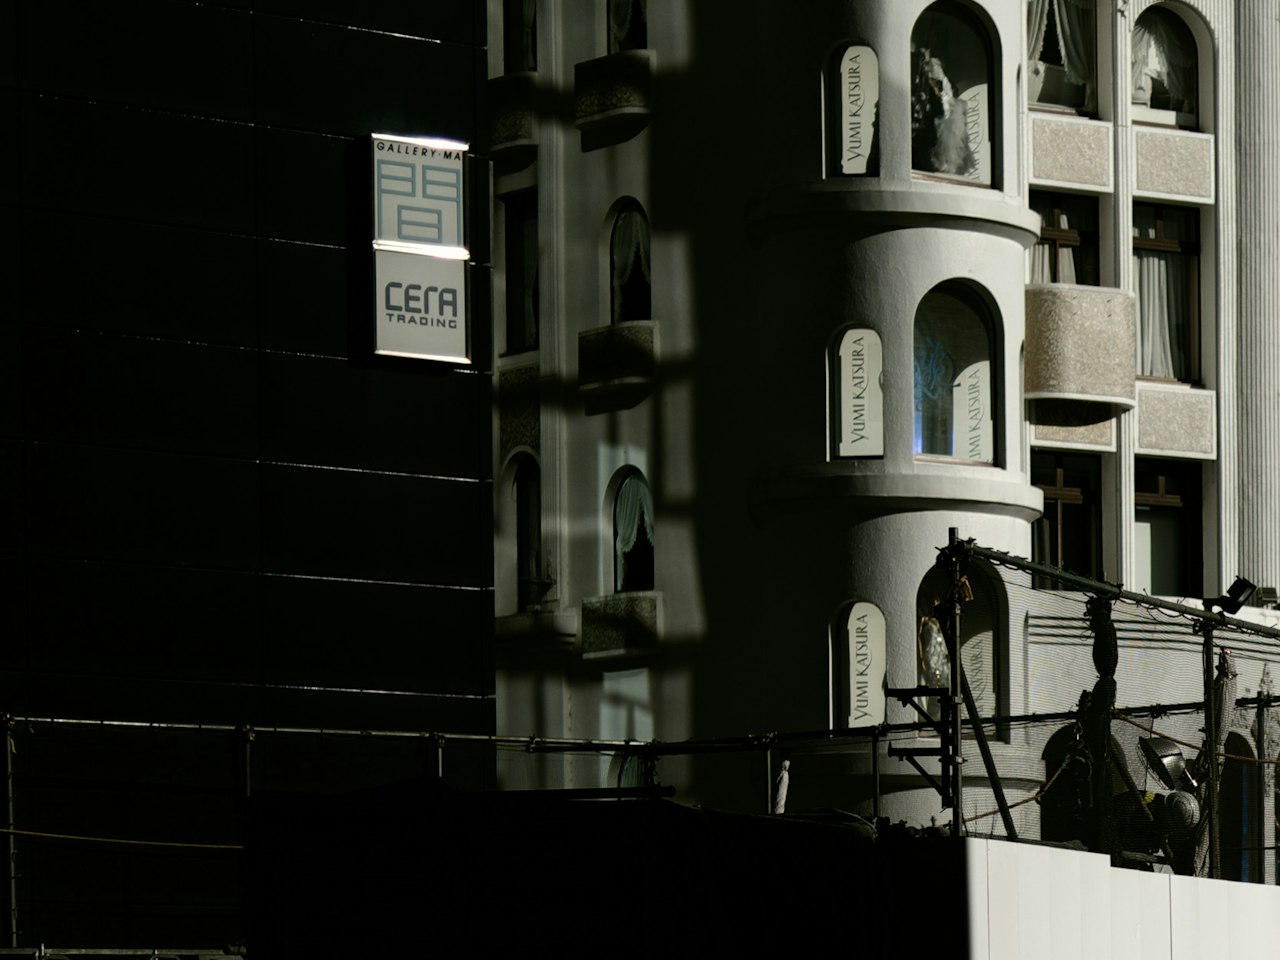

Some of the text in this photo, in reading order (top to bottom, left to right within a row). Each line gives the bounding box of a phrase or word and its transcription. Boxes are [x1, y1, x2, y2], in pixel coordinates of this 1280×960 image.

[847, 54, 866, 162] YUMI KATSURA
[385, 313, 458, 329] TRADING
[851, 336, 869, 444] YUMI KATSURA
[968, 368, 985, 433] KATSURA
[854, 613, 873, 721] YUMI KATSURA
